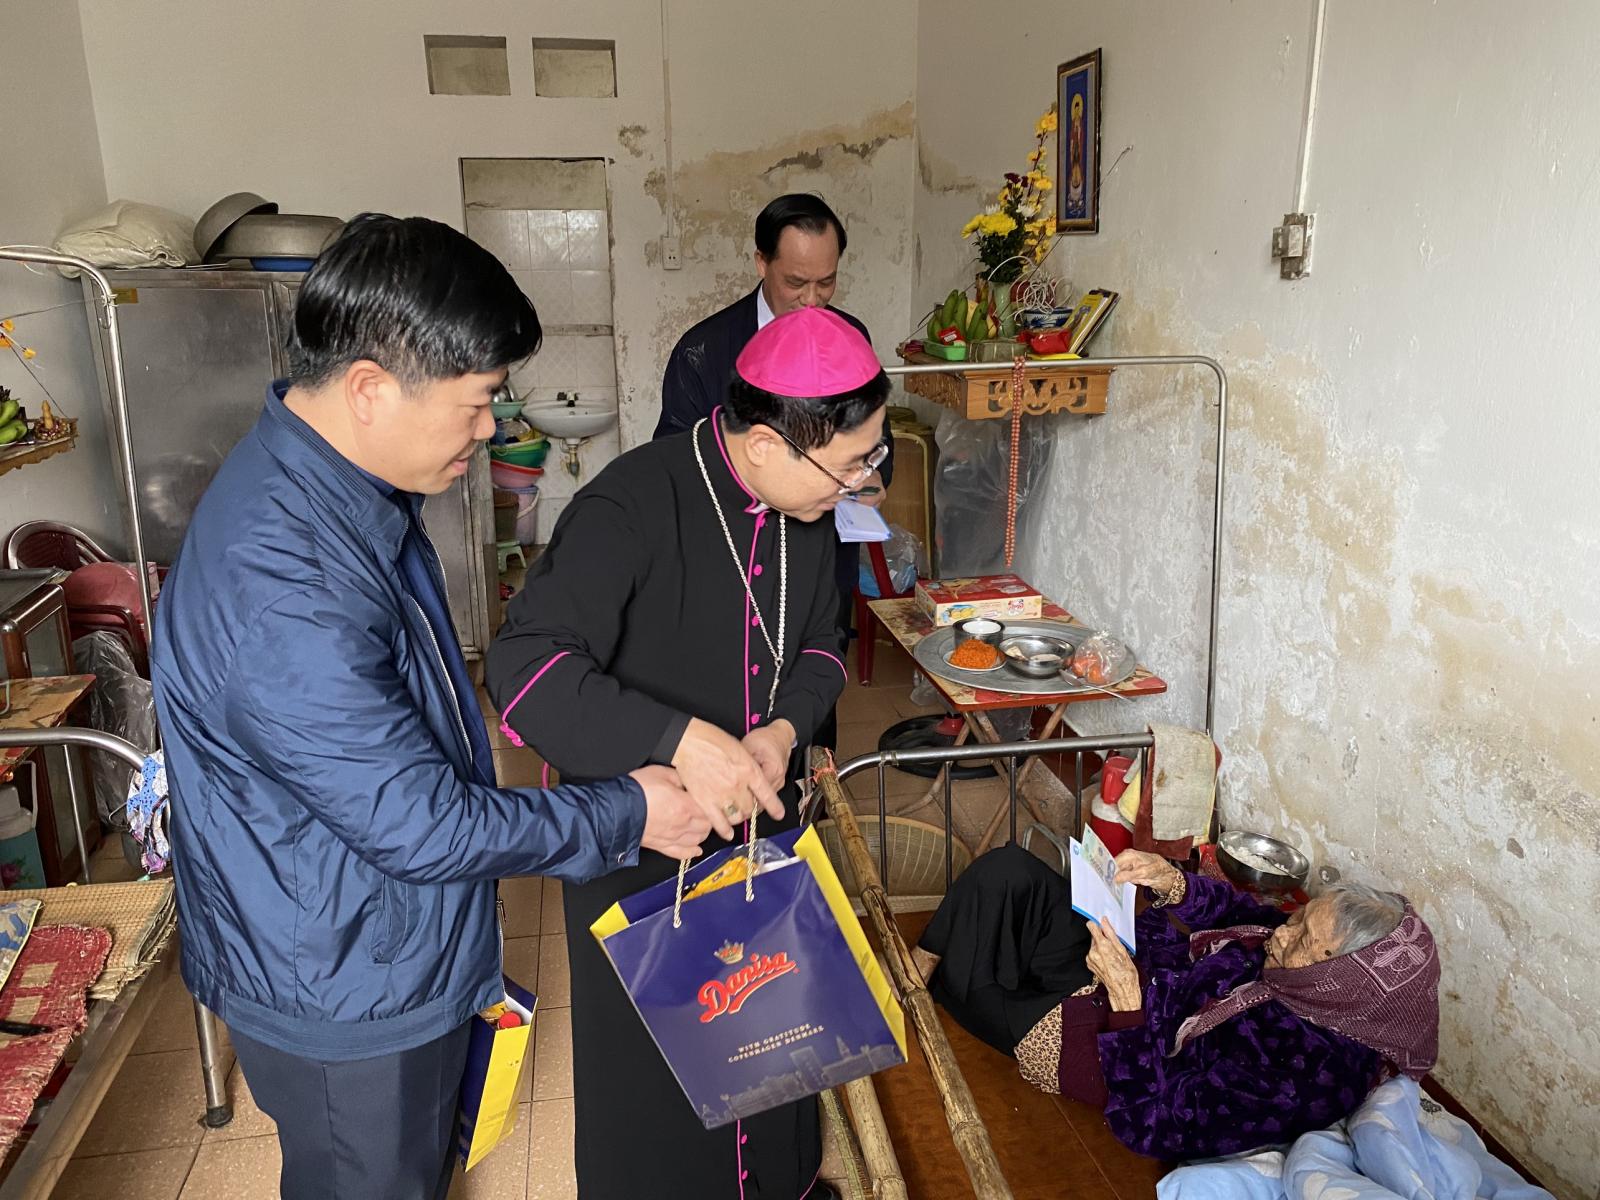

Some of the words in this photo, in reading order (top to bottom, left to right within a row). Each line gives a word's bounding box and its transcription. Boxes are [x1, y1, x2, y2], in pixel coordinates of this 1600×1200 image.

[697, 951, 797, 1023] Danisa
[728, 1042, 782, 1063] COPENHAGEN
[784, 1025, 824, 1045] DENMARK
[738, 1041, 760, 1053] WITH
